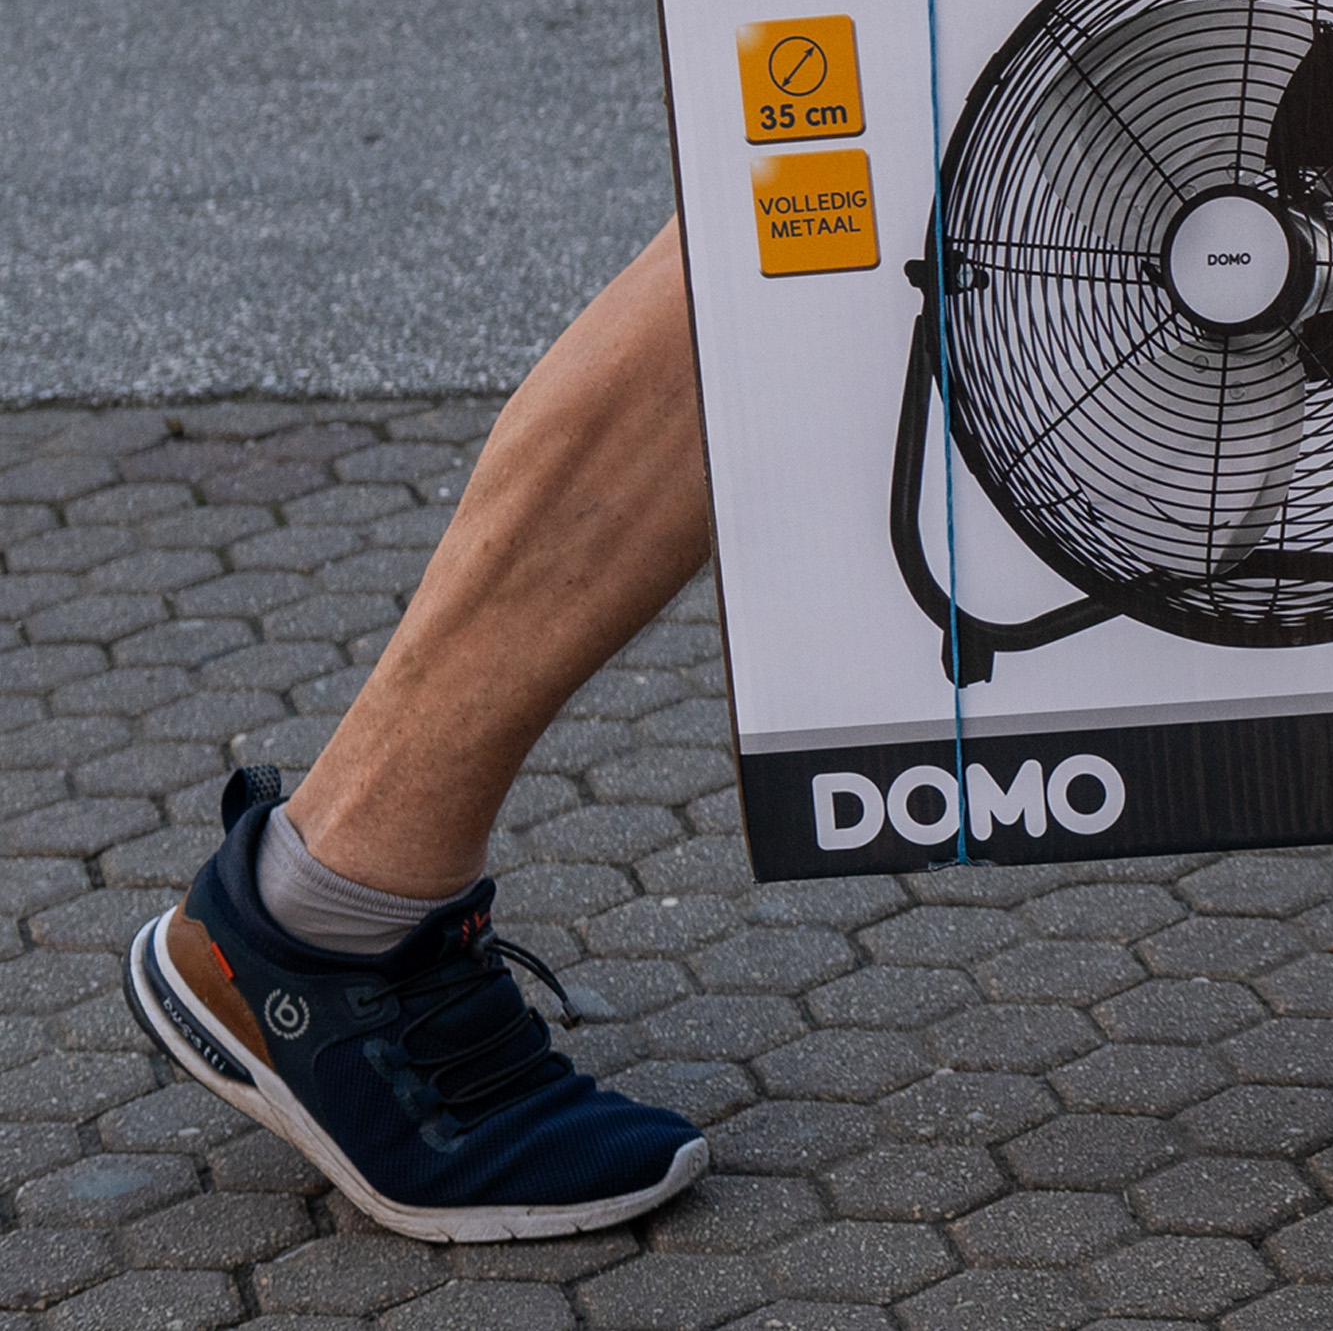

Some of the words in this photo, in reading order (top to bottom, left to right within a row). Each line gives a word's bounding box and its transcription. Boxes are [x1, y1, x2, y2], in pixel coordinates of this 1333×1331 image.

[760, 104, 795, 131] 35
[805, 104, 848, 127] cm
[758, 190, 867, 215] VOLLEDIG
[770, 215, 861, 239] METAAL
[1207, 253, 1251, 266] DOMO
[812, 753, 1126, 852] DOMO
